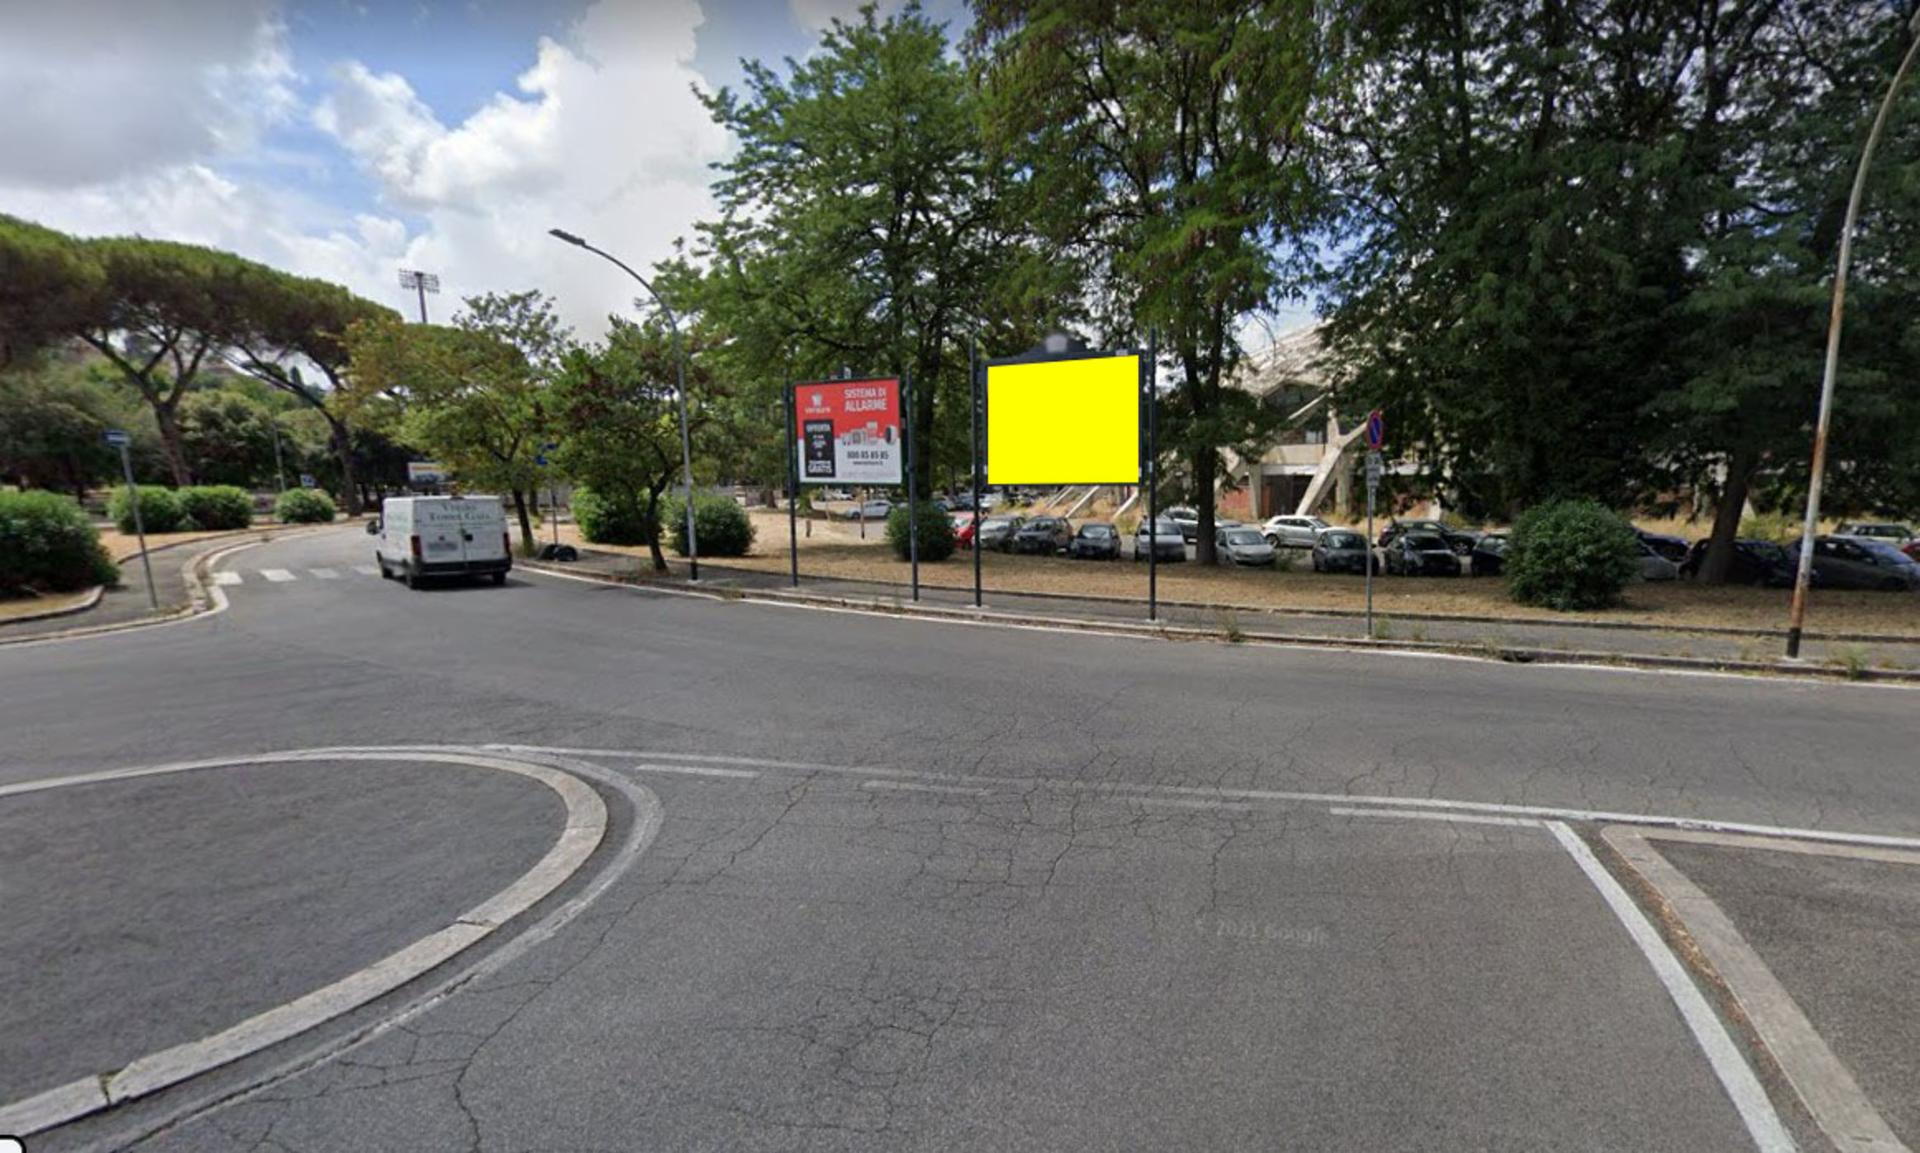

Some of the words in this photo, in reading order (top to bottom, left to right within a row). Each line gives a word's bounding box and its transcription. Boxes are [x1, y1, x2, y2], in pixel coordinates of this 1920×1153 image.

[845, 388, 876, 399] SISTEMA
[878, 387, 887, 397] DI
[845, 399, 887, 412] ALLARME
